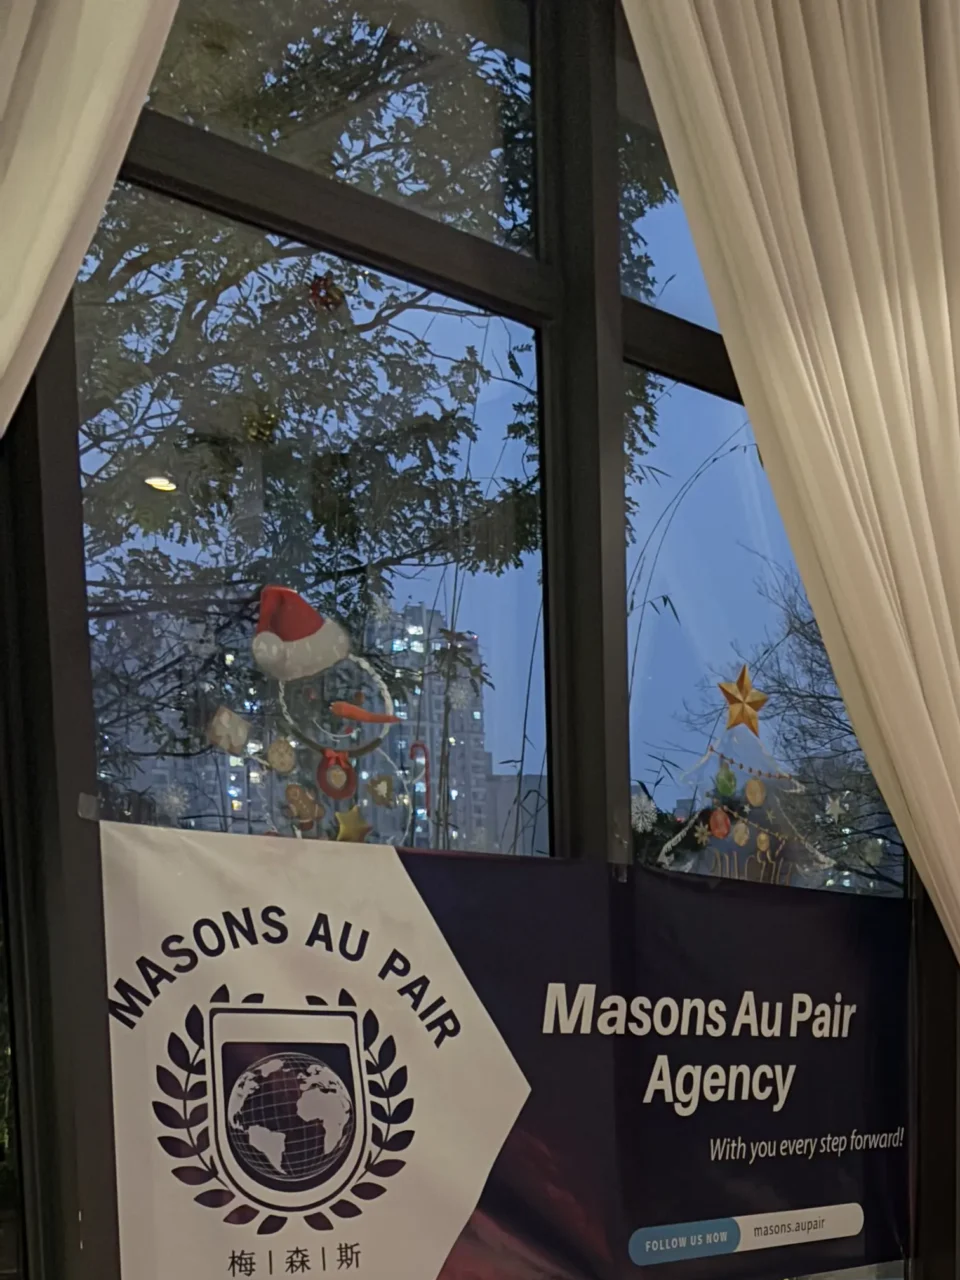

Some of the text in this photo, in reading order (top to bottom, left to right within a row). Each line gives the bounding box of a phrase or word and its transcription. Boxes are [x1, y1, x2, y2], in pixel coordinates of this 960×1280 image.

[108, 905, 461, 1048] MASONS AU PAIR
[542, 983, 856, 1038] Masons Au Pair
[643, 1055, 796, 1116] Agency
[710, 1127, 904, 1164] With you every step forward!
[645, 1231, 728, 1252] FOLLOW US NOW
[753, 1215, 826, 1237] masons.aupair
